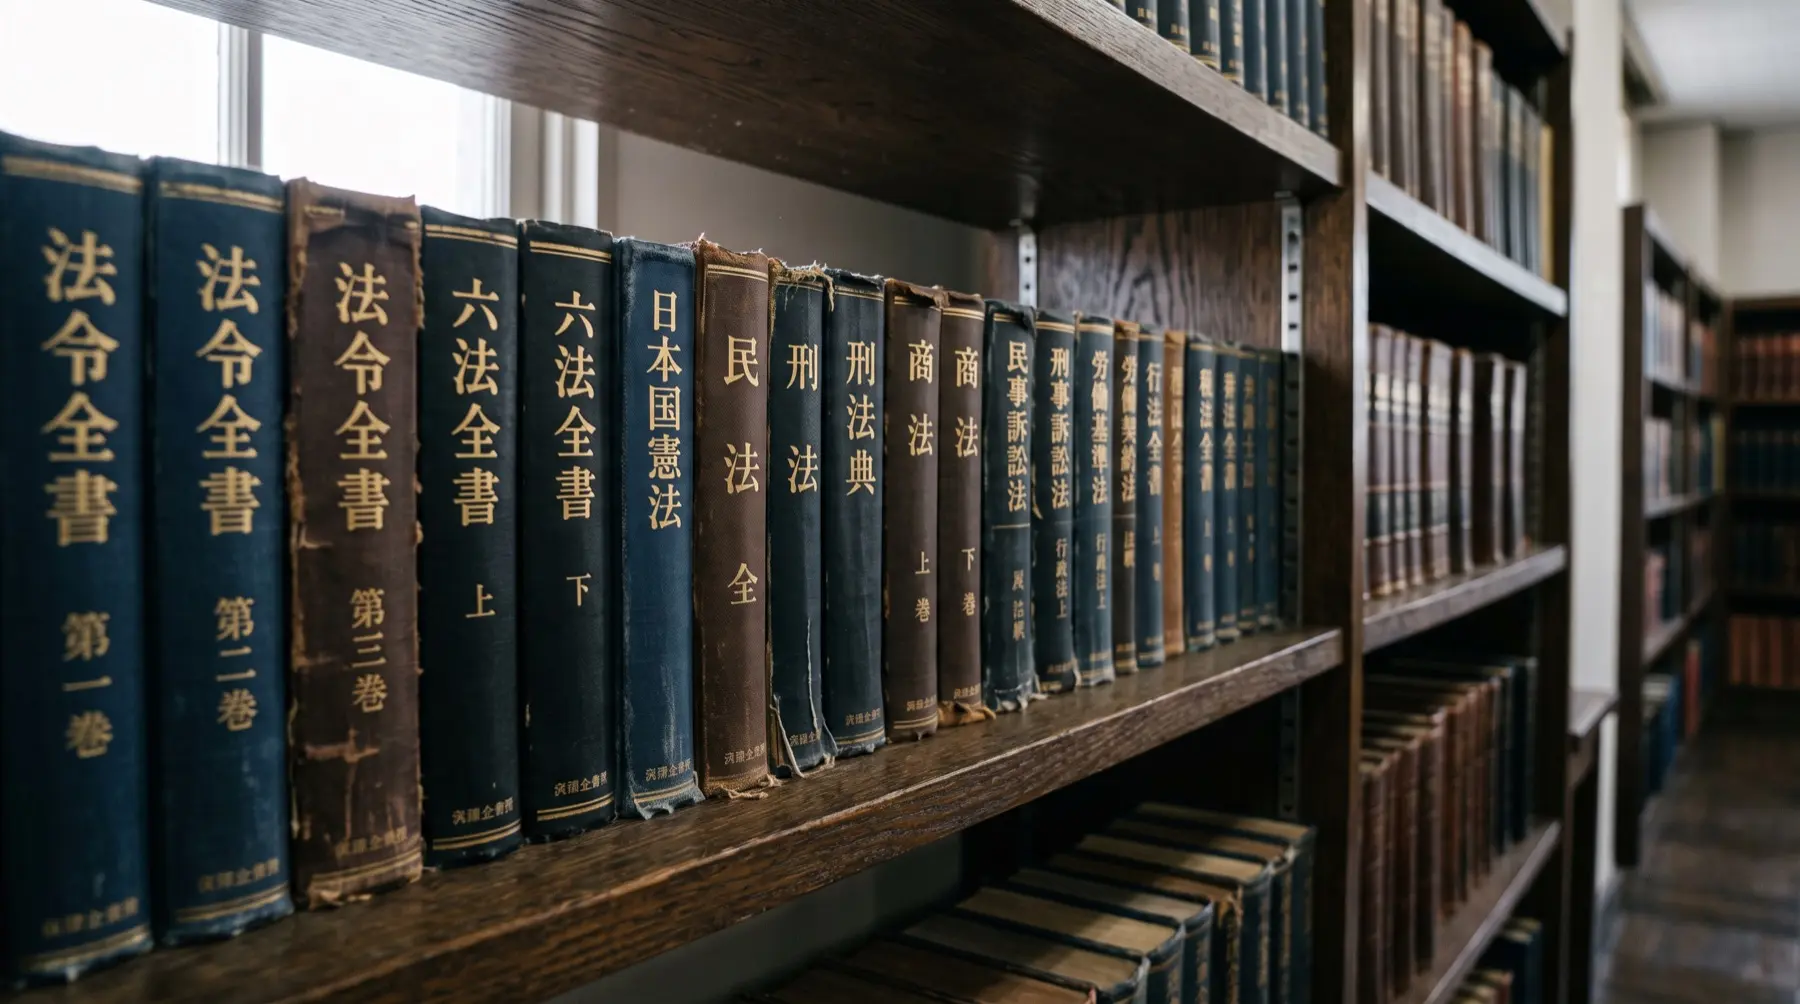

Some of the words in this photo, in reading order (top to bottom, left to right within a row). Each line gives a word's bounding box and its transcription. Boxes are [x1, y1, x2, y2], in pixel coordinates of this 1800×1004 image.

[41, 226, 120, 547] 法令全書
[195, 243, 263, 536] 法令全書
[333, 262, 392, 532] 法令全書
[451, 278, 501, 527] 六法全書
[554, 290, 597, 520] 六法全書
[646, 289, 682, 530] 日本国憲法
[786, 343, 819, 494] 刑法
[845, 340, 877, 496] 刑法典
[908, 339, 934, 457] 商法
[954, 346, 979, 458] 商法
[1006, 340, 1029, 512] 民事訴訟法
[1050, 347, 1070, 509] 刑事訴訟法
[465, 584, 496, 618] 上
[566, 573, 592, 607] 下
